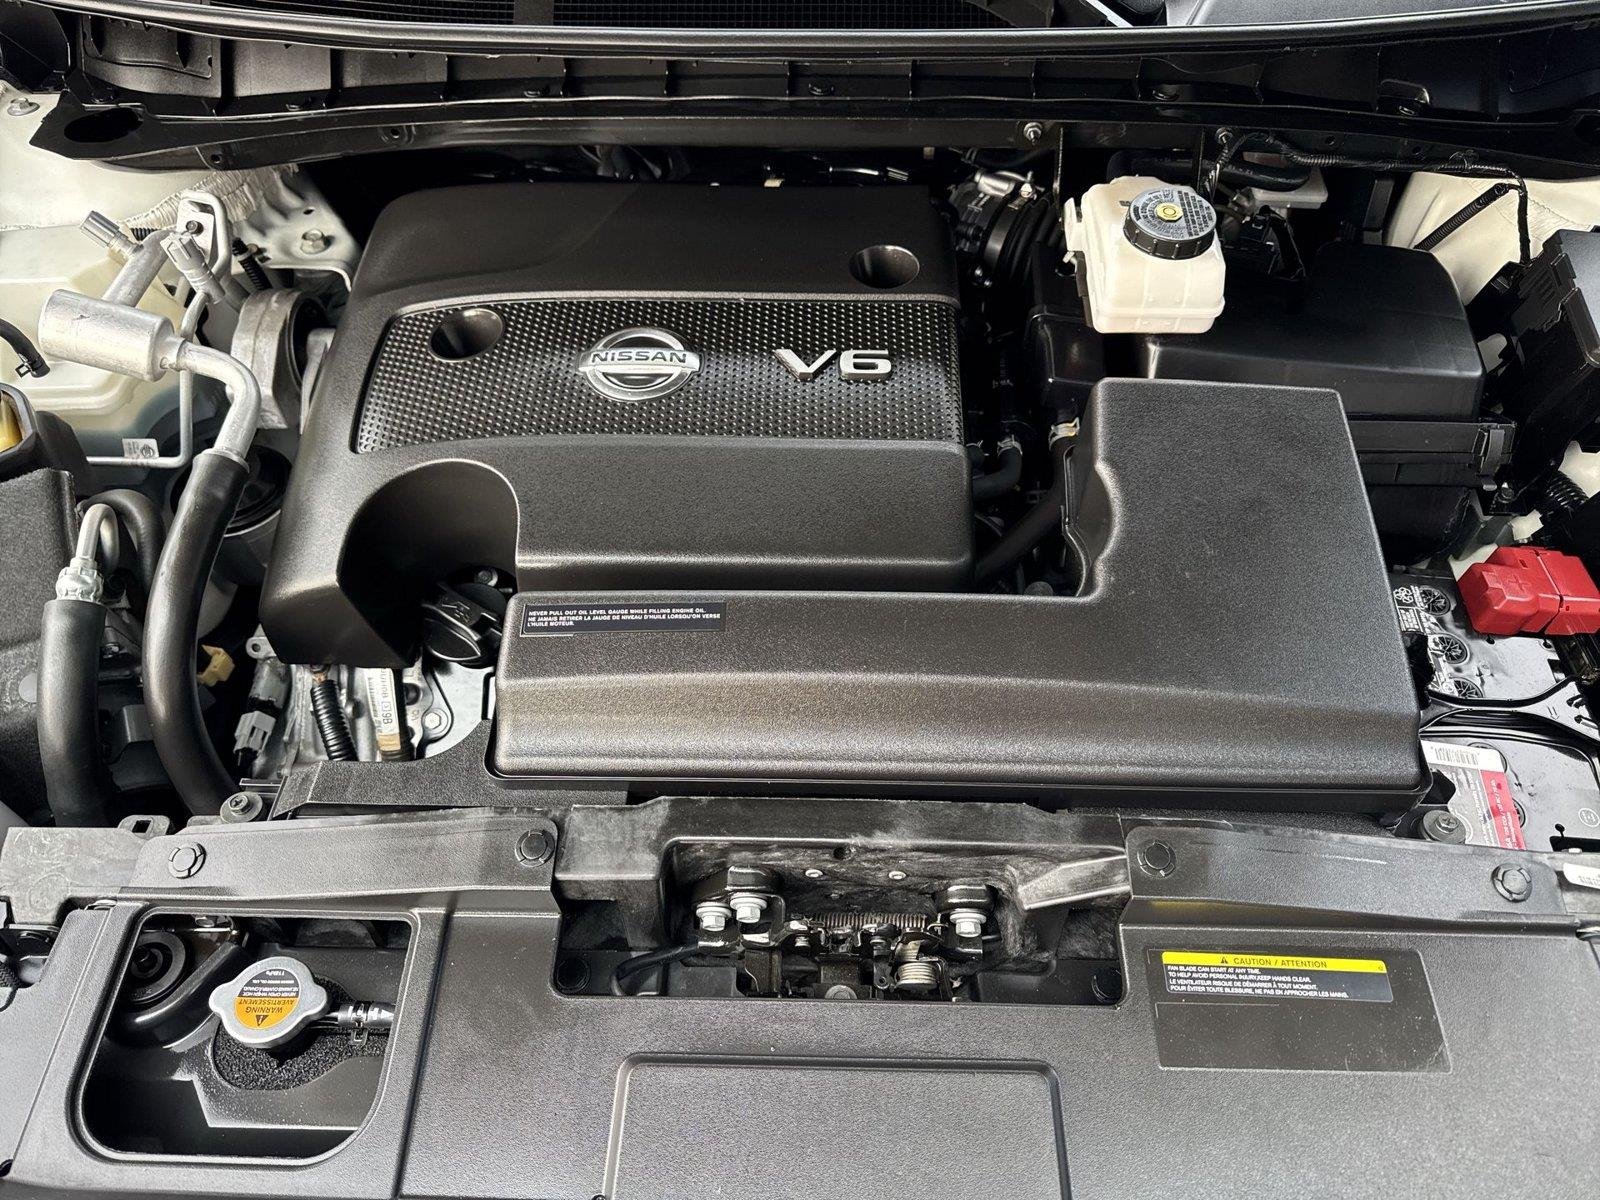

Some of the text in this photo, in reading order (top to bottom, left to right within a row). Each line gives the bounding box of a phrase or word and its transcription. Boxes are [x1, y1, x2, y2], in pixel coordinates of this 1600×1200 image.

[590, 350, 687, 364] NISSAN
[773, 348, 892, 380] V6
[1233, 957, 1271, 966] CAUTION
[1281, 960, 1327, 968] ATTENTION
